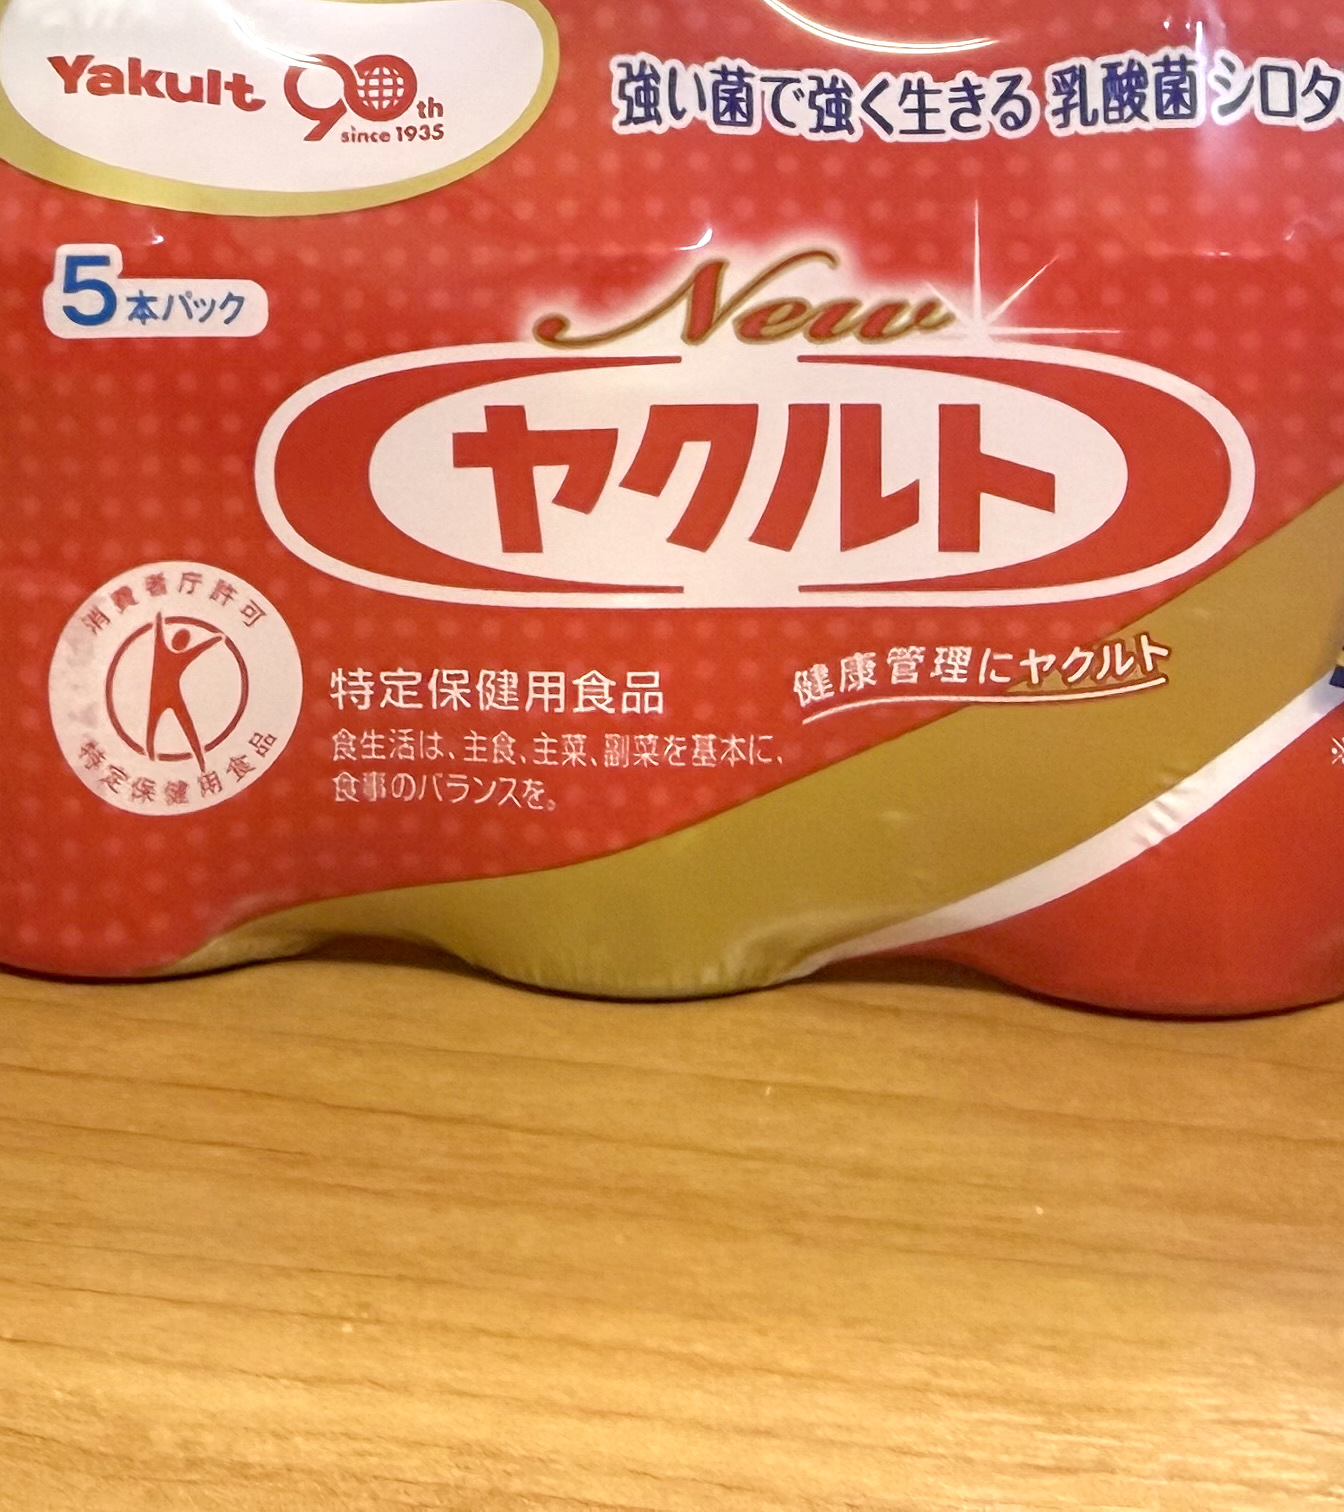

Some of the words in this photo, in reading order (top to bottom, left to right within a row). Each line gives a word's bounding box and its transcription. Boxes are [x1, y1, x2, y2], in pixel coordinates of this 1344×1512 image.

[47, 55, 265, 112] Yakult
[340, 126, 391, 144] since
[395, 124, 445, 143] 1935
[62, 255, 246, 326] 5本パック
[532, 248, 956, 348] New
[452, 402, 1057, 555] ヤクルト
[330, 666, 664, 715] 特定保健用食品
[793, 633, 1170, 707] 健康管理にヤクルト
[332, 770, 556, 812] 食事のバランスを。
